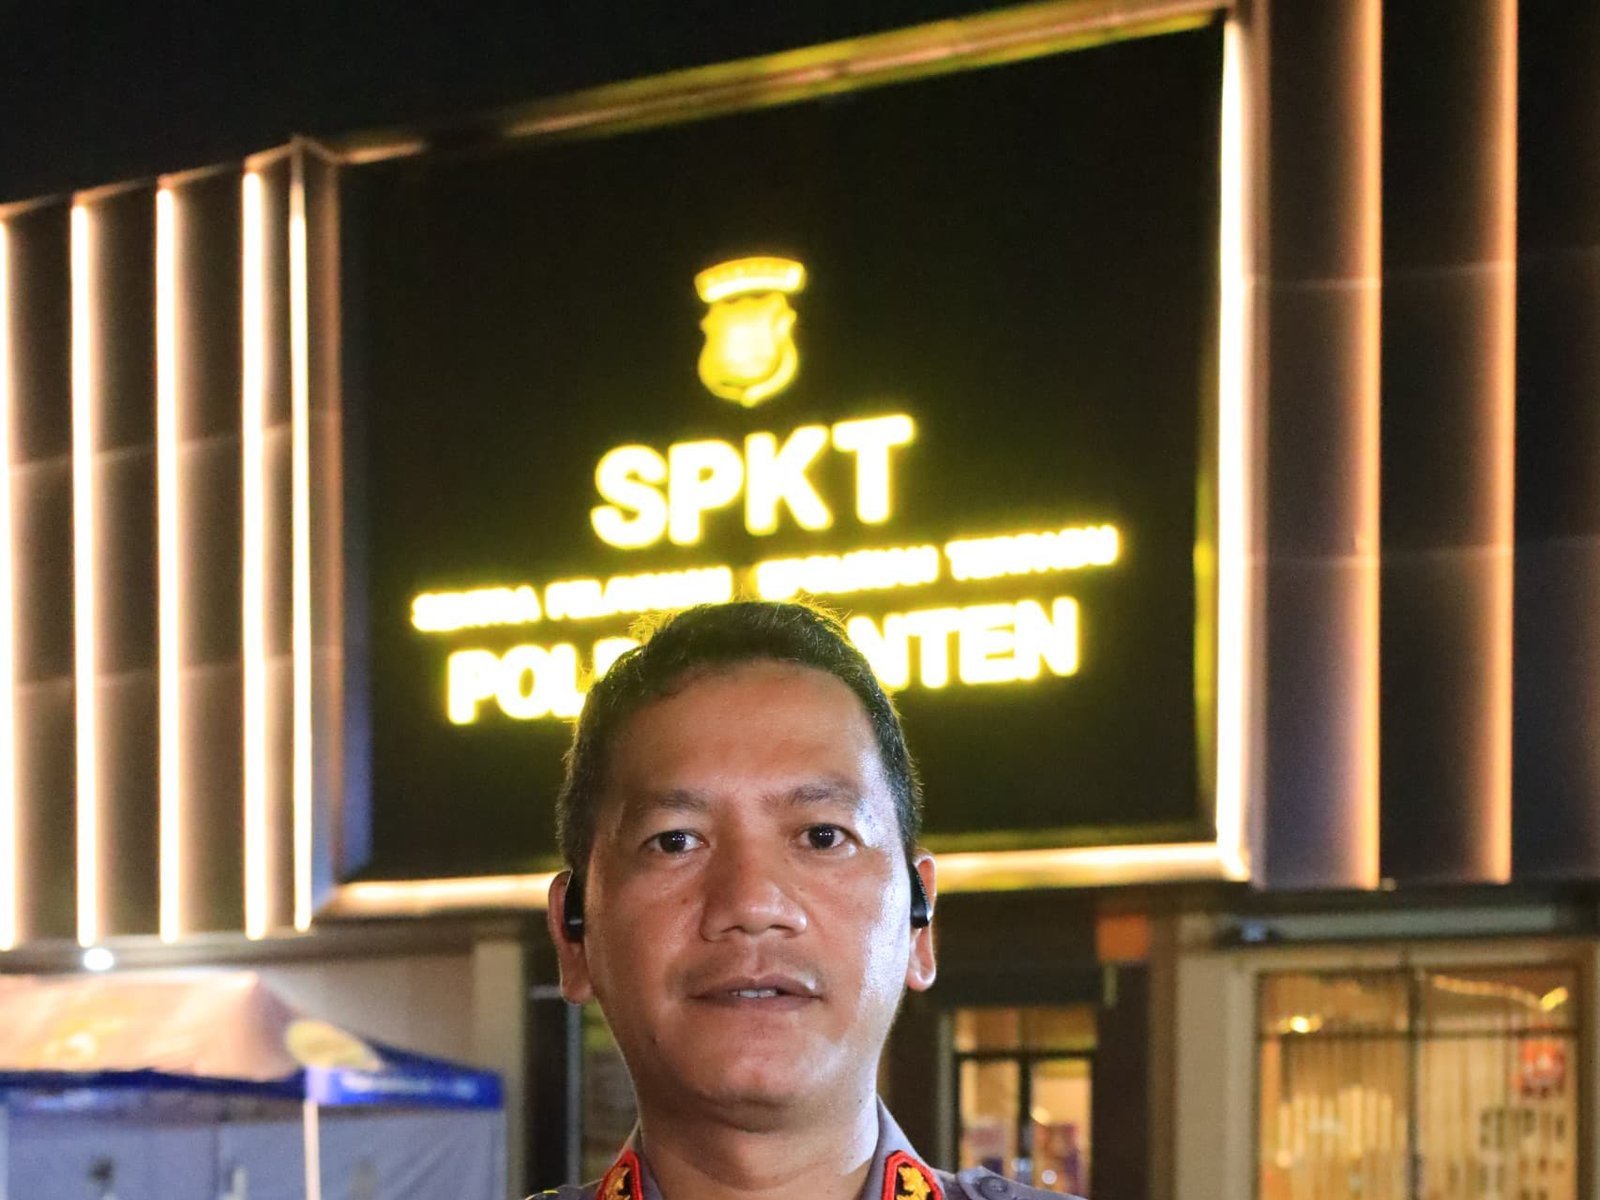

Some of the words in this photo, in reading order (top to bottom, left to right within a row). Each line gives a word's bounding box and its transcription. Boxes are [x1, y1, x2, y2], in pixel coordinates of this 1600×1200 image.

[590, 413, 916, 549] SPKT
[447, 636, 642, 725] POL
[846, 596, 1079, 690] NTEN
